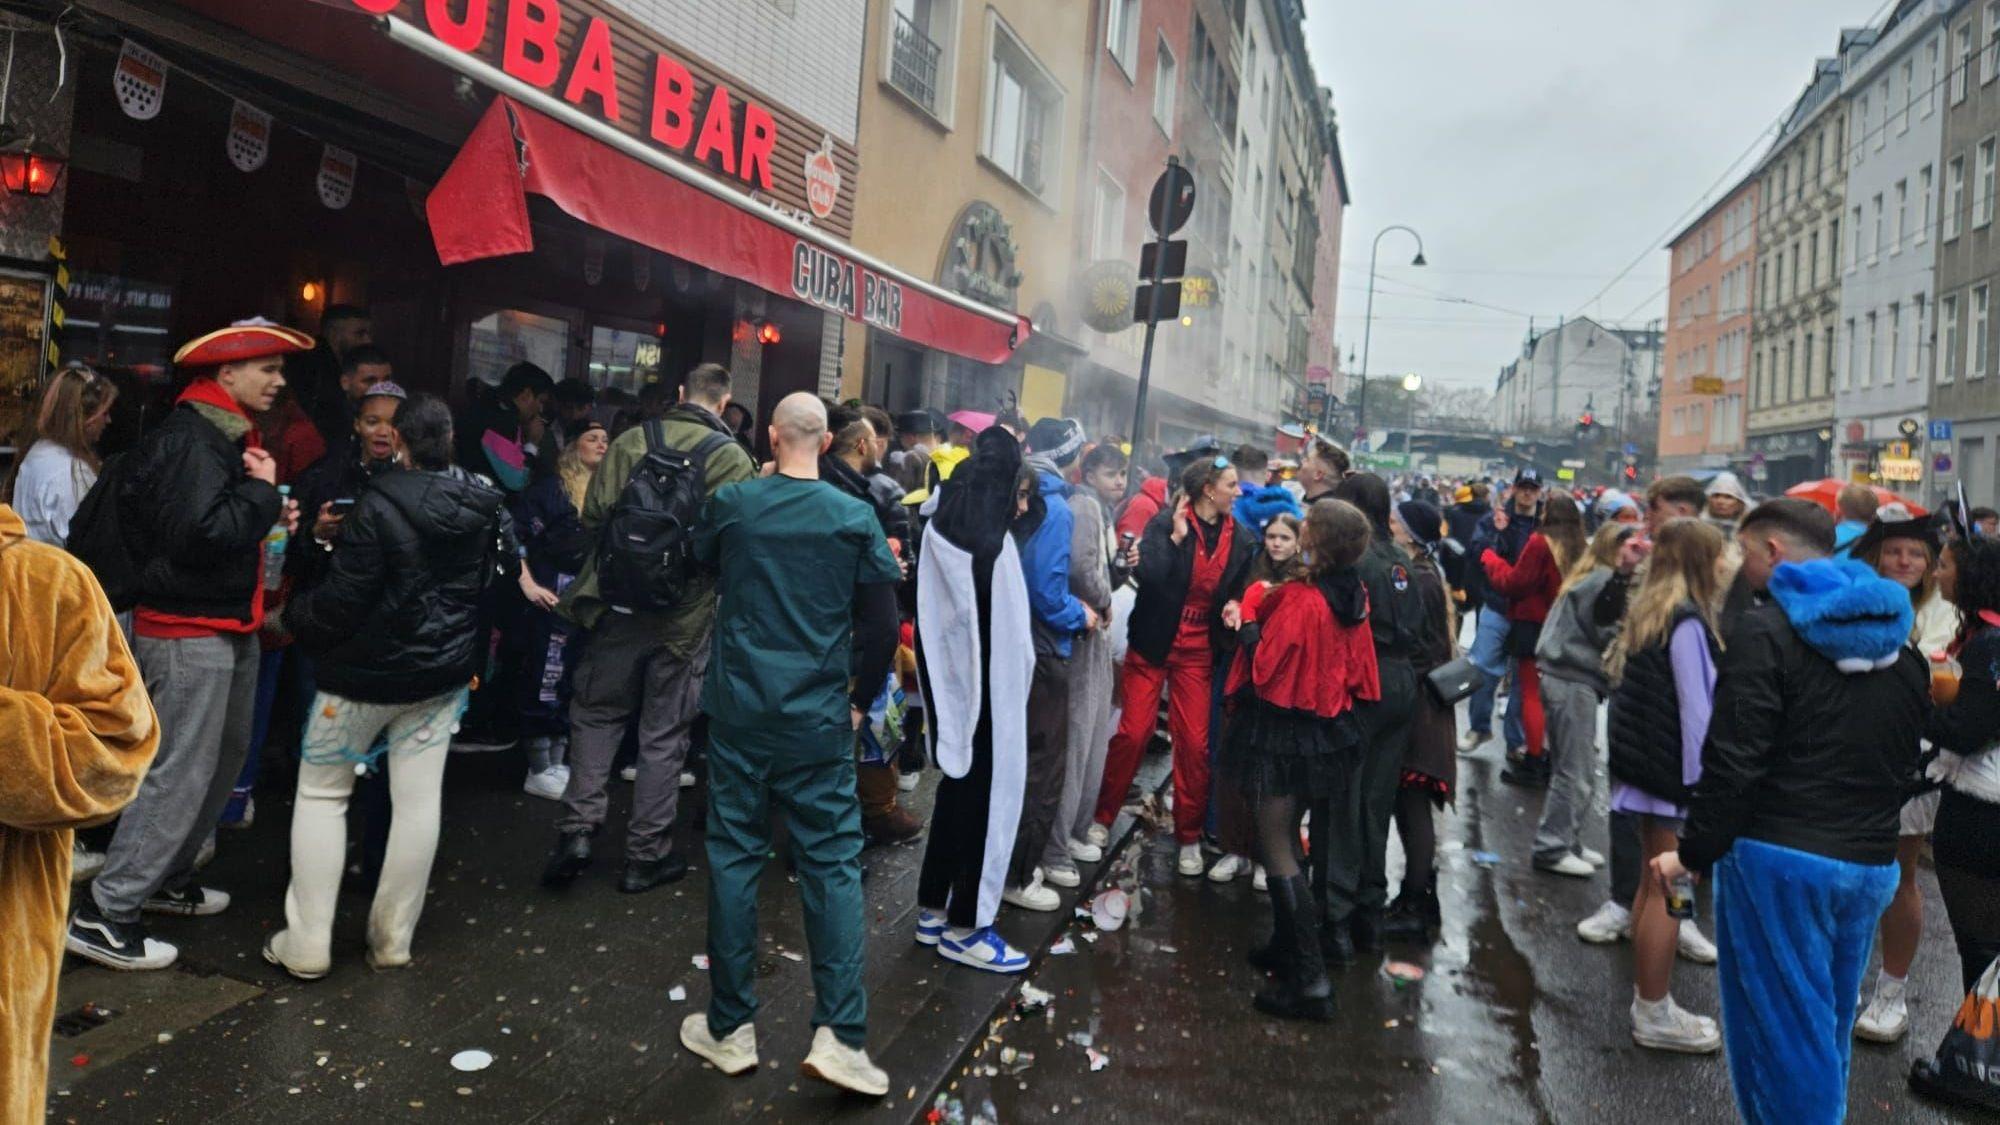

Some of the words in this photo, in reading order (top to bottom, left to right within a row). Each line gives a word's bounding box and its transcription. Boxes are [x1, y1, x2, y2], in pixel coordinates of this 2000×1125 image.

[354, 0, 620, 121] UBA
[651, 53, 778, 190] BAR
[793, 241, 856, 316] CUBA
[863, 271, 903, 332] BAR
